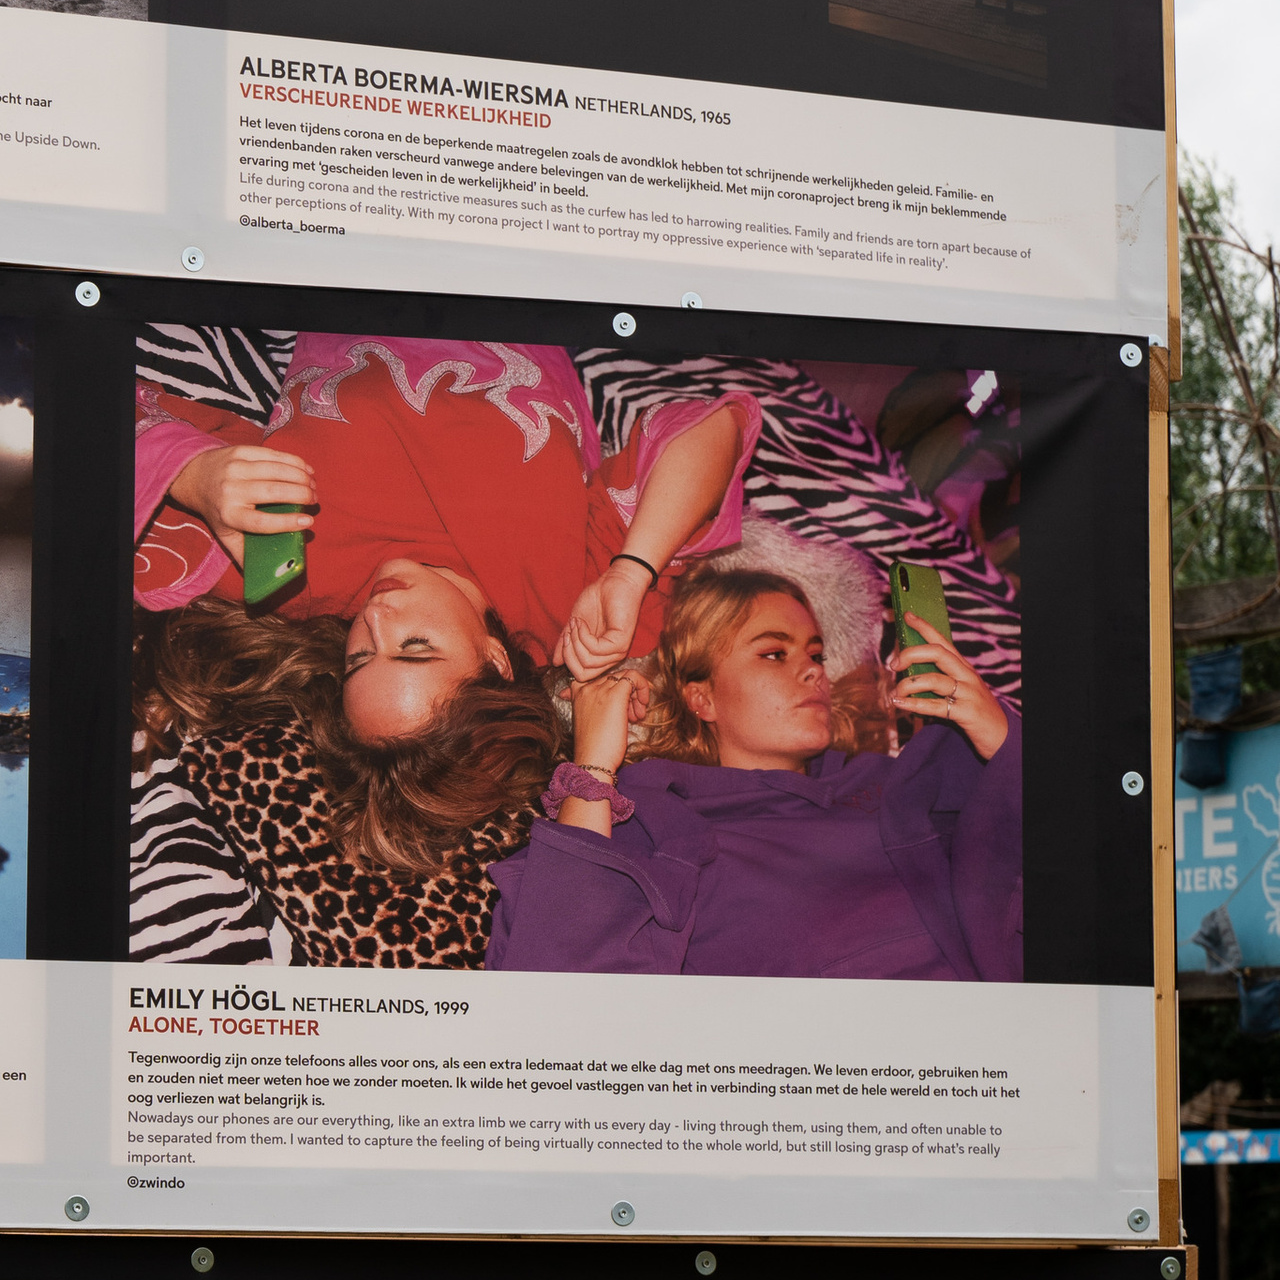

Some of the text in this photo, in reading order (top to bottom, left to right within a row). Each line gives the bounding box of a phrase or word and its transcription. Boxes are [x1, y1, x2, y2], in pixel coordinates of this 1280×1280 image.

[239, 55, 732, 126] ALBERTA BOERMA-WIERSMA NETHERLANDS, 1965
[25, 97, 53, 108] naar
[239, 82, 552, 129] VERSCHEURENDE WERKELIJKHEID
[238, 135, 1007, 222] vriendenbanden raken verscheurd vanwege andere belevingen van de werkelijkheid. Met mijn coronaproject breng ik mijn beklemmende
[239, 214, 346, 236] @alberta_boerma
[130, 984, 470, 1017] EMILY HÖGL NETHERLANDS, 1999
[128, 1015, 320, 1037] ALONE, TOGETHER
[127, 1091, 325, 1110] oog verliezen wat belangrijk is.
[127, 1150, 196, 1167] important.
[126, 1175, 186, 1189] @zwindo
